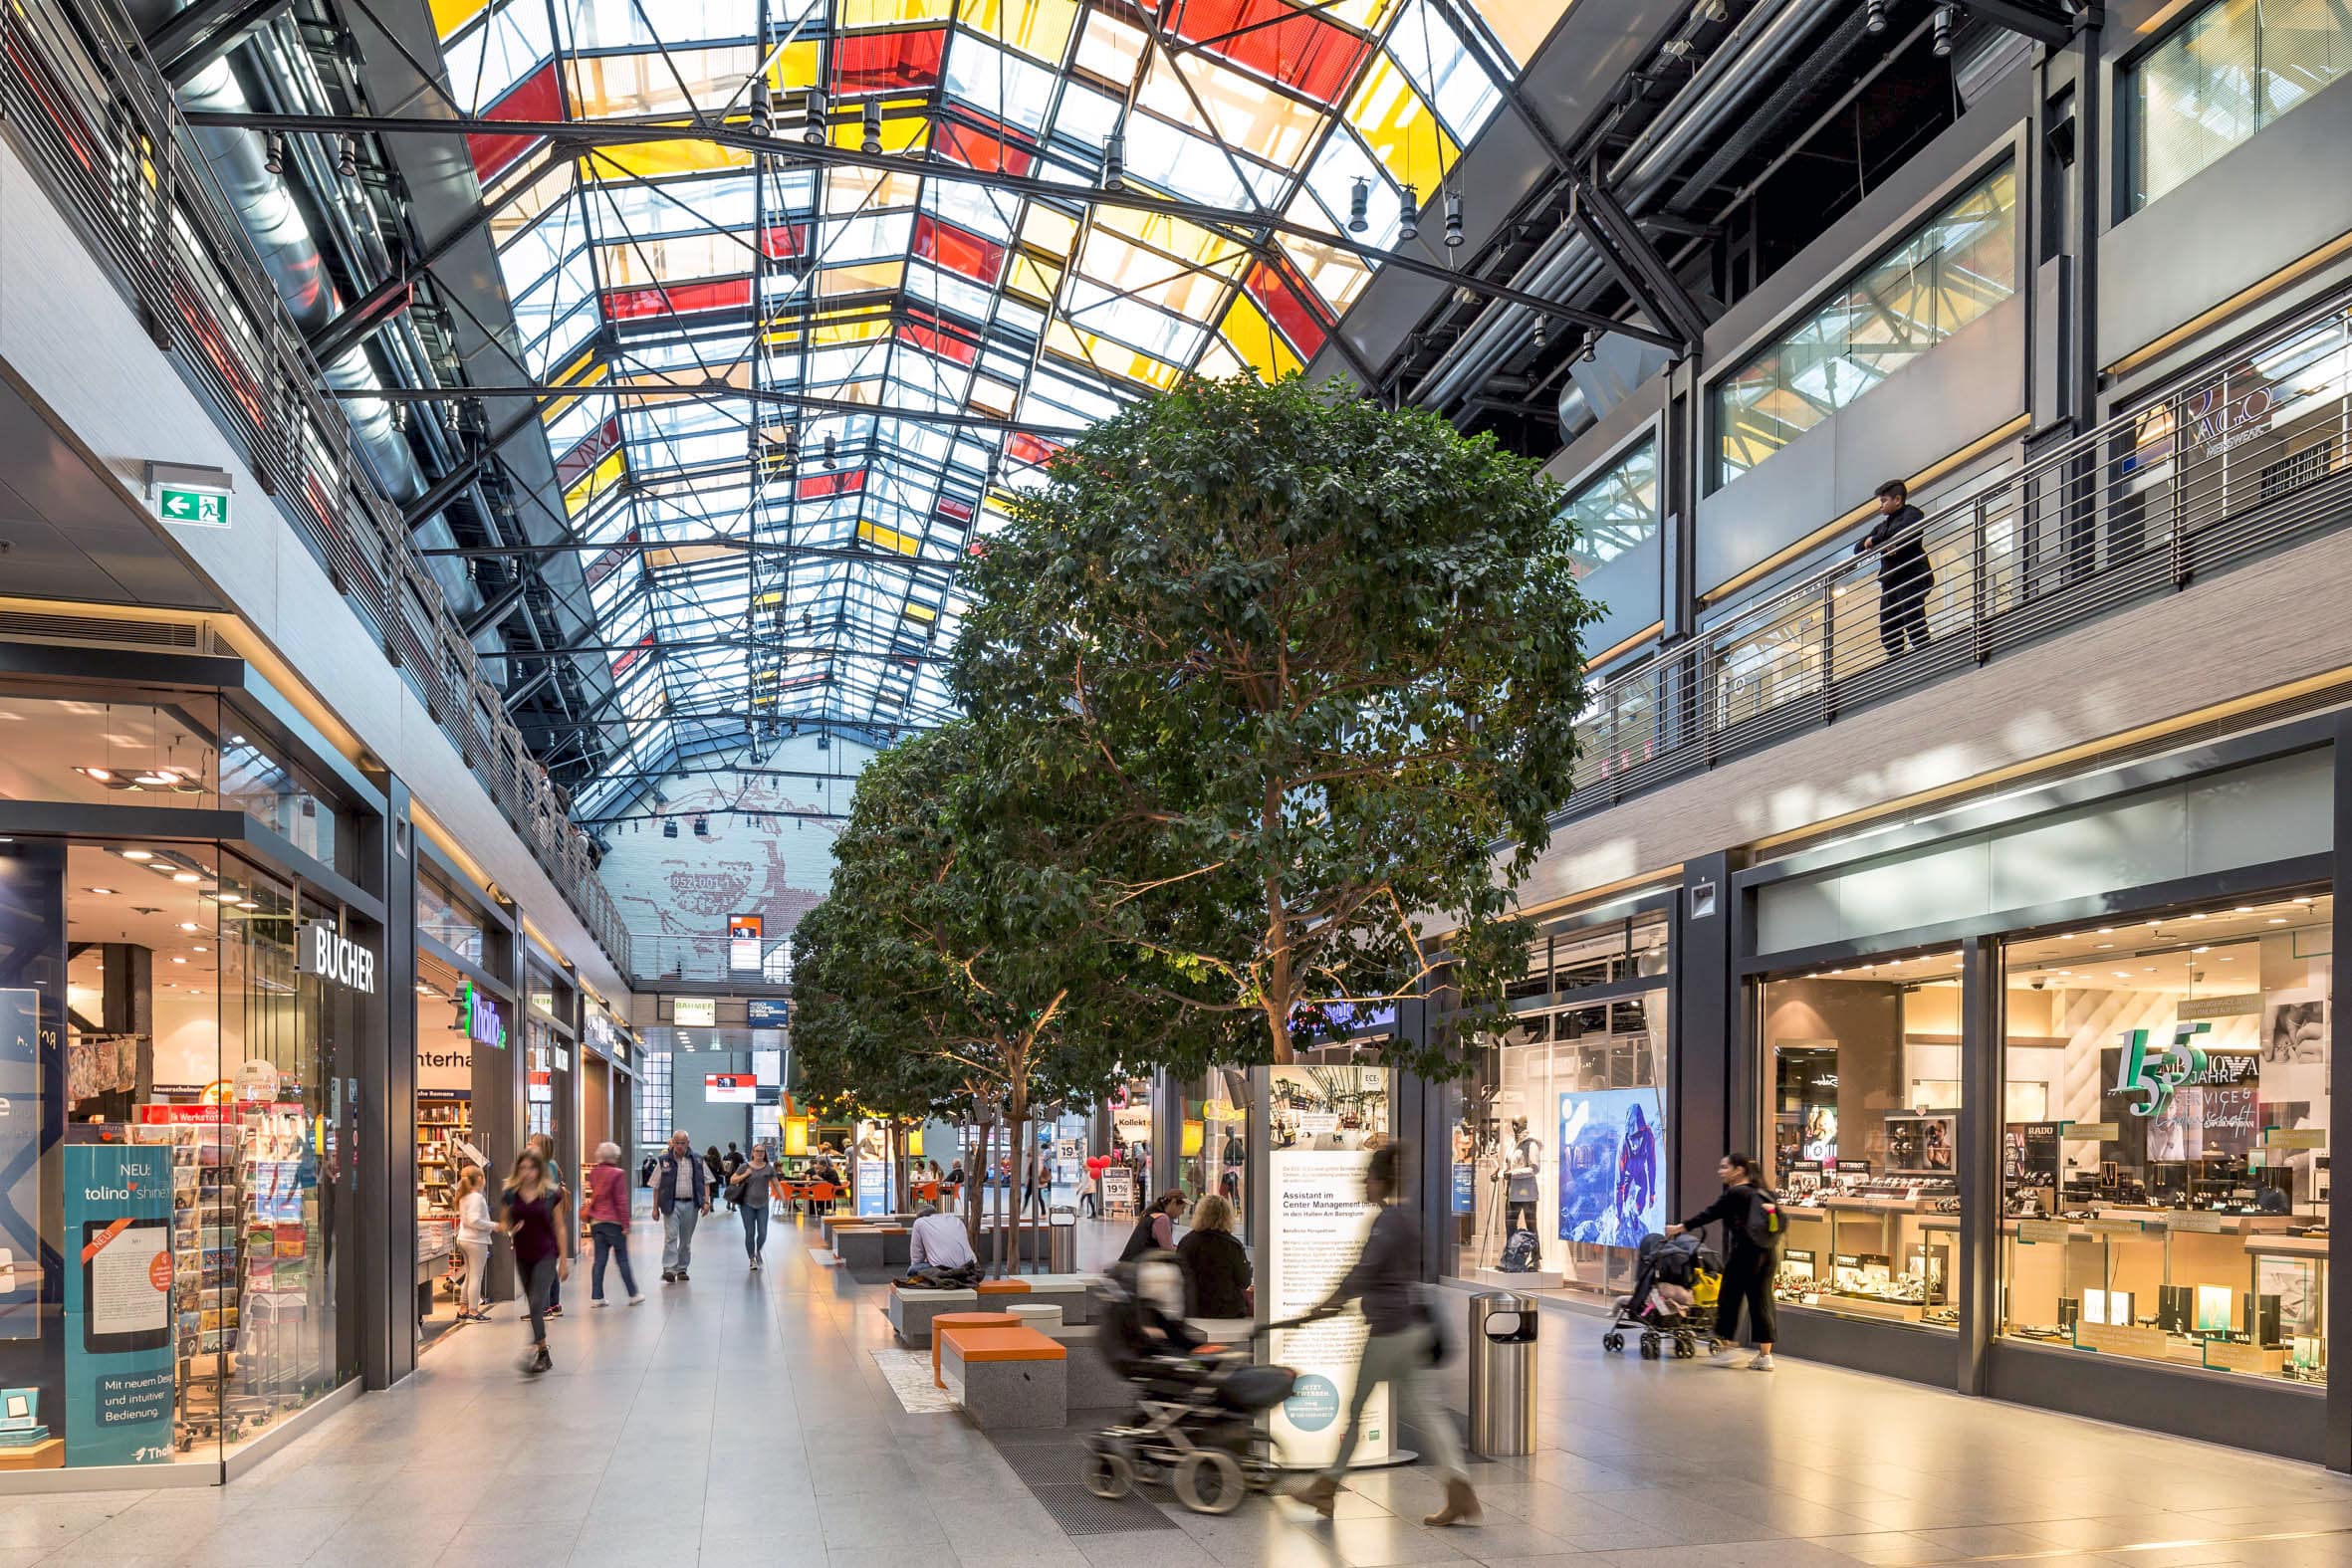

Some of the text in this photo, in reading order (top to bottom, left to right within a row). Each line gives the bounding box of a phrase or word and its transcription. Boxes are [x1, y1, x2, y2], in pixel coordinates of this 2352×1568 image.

[316, 919, 374, 994] BÜCHER
[2192, 1069, 2237, 1084] JAHRE
[2176, 1089, 2239, 1104] SERVICE
[180, 1112, 225, 1121] Werkstatt
[2028, 1126, 2053, 1135] RADO
[85, 1186, 129, 1201] tolino
[1312, 1201, 1360, 1210] Management
[105, 1380, 121, 1391] Mit
[124, 1378, 156, 1389] neuem
[105, 1391, 165, 1406] und intuitiver
